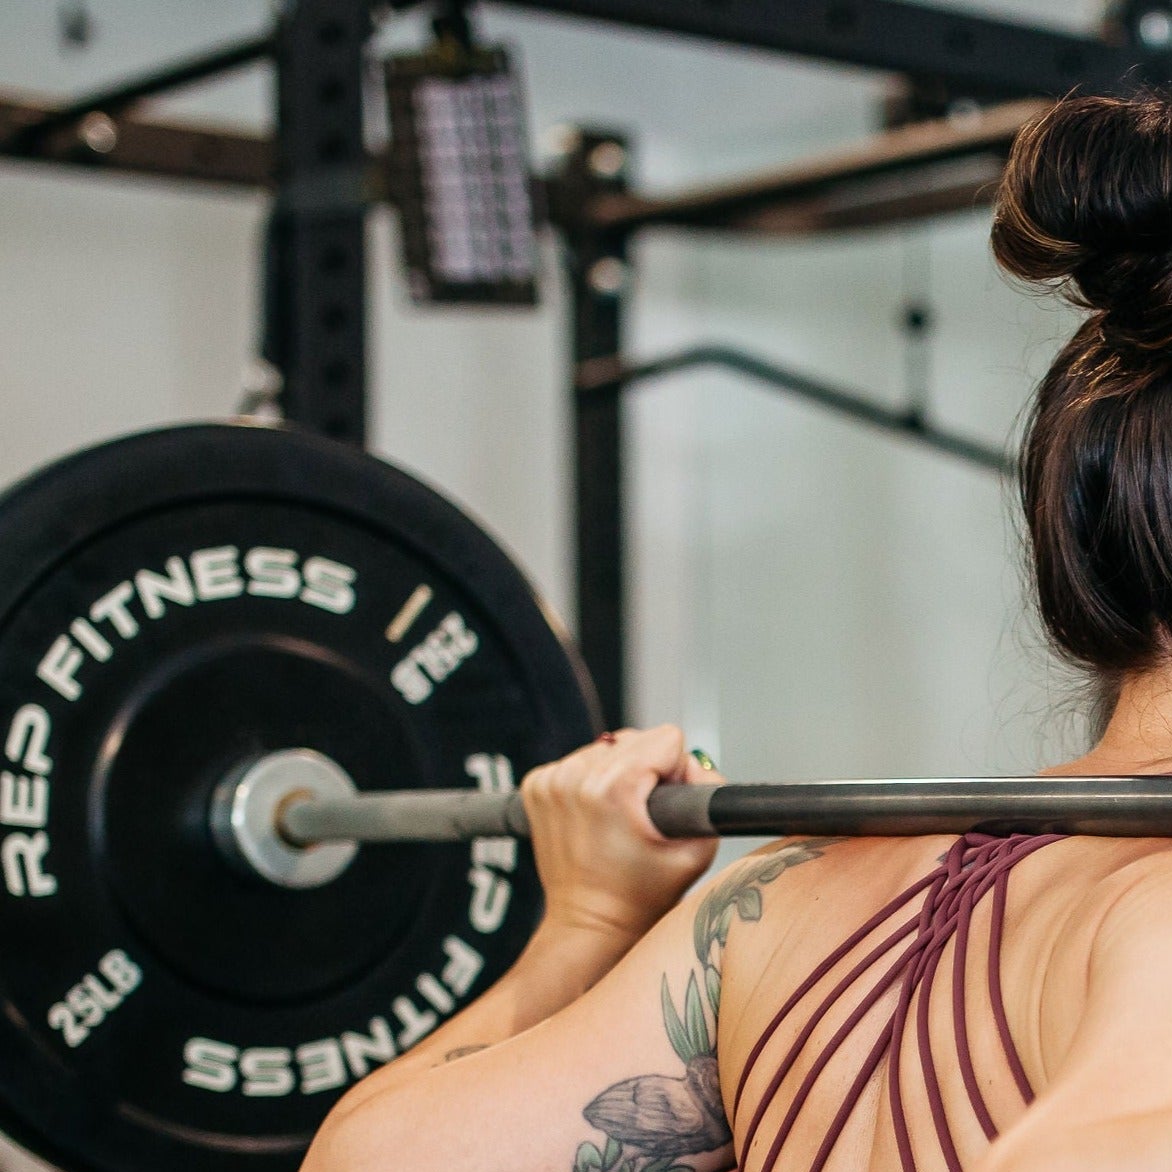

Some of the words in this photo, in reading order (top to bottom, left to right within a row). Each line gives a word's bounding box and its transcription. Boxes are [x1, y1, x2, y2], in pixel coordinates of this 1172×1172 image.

[0, 703, 57, 897] REP
[36, 545, 357, 701] FITNESS
[48, 948, 142, 1048] 25LB
[182, 935, 484, 1097] FITNESS
